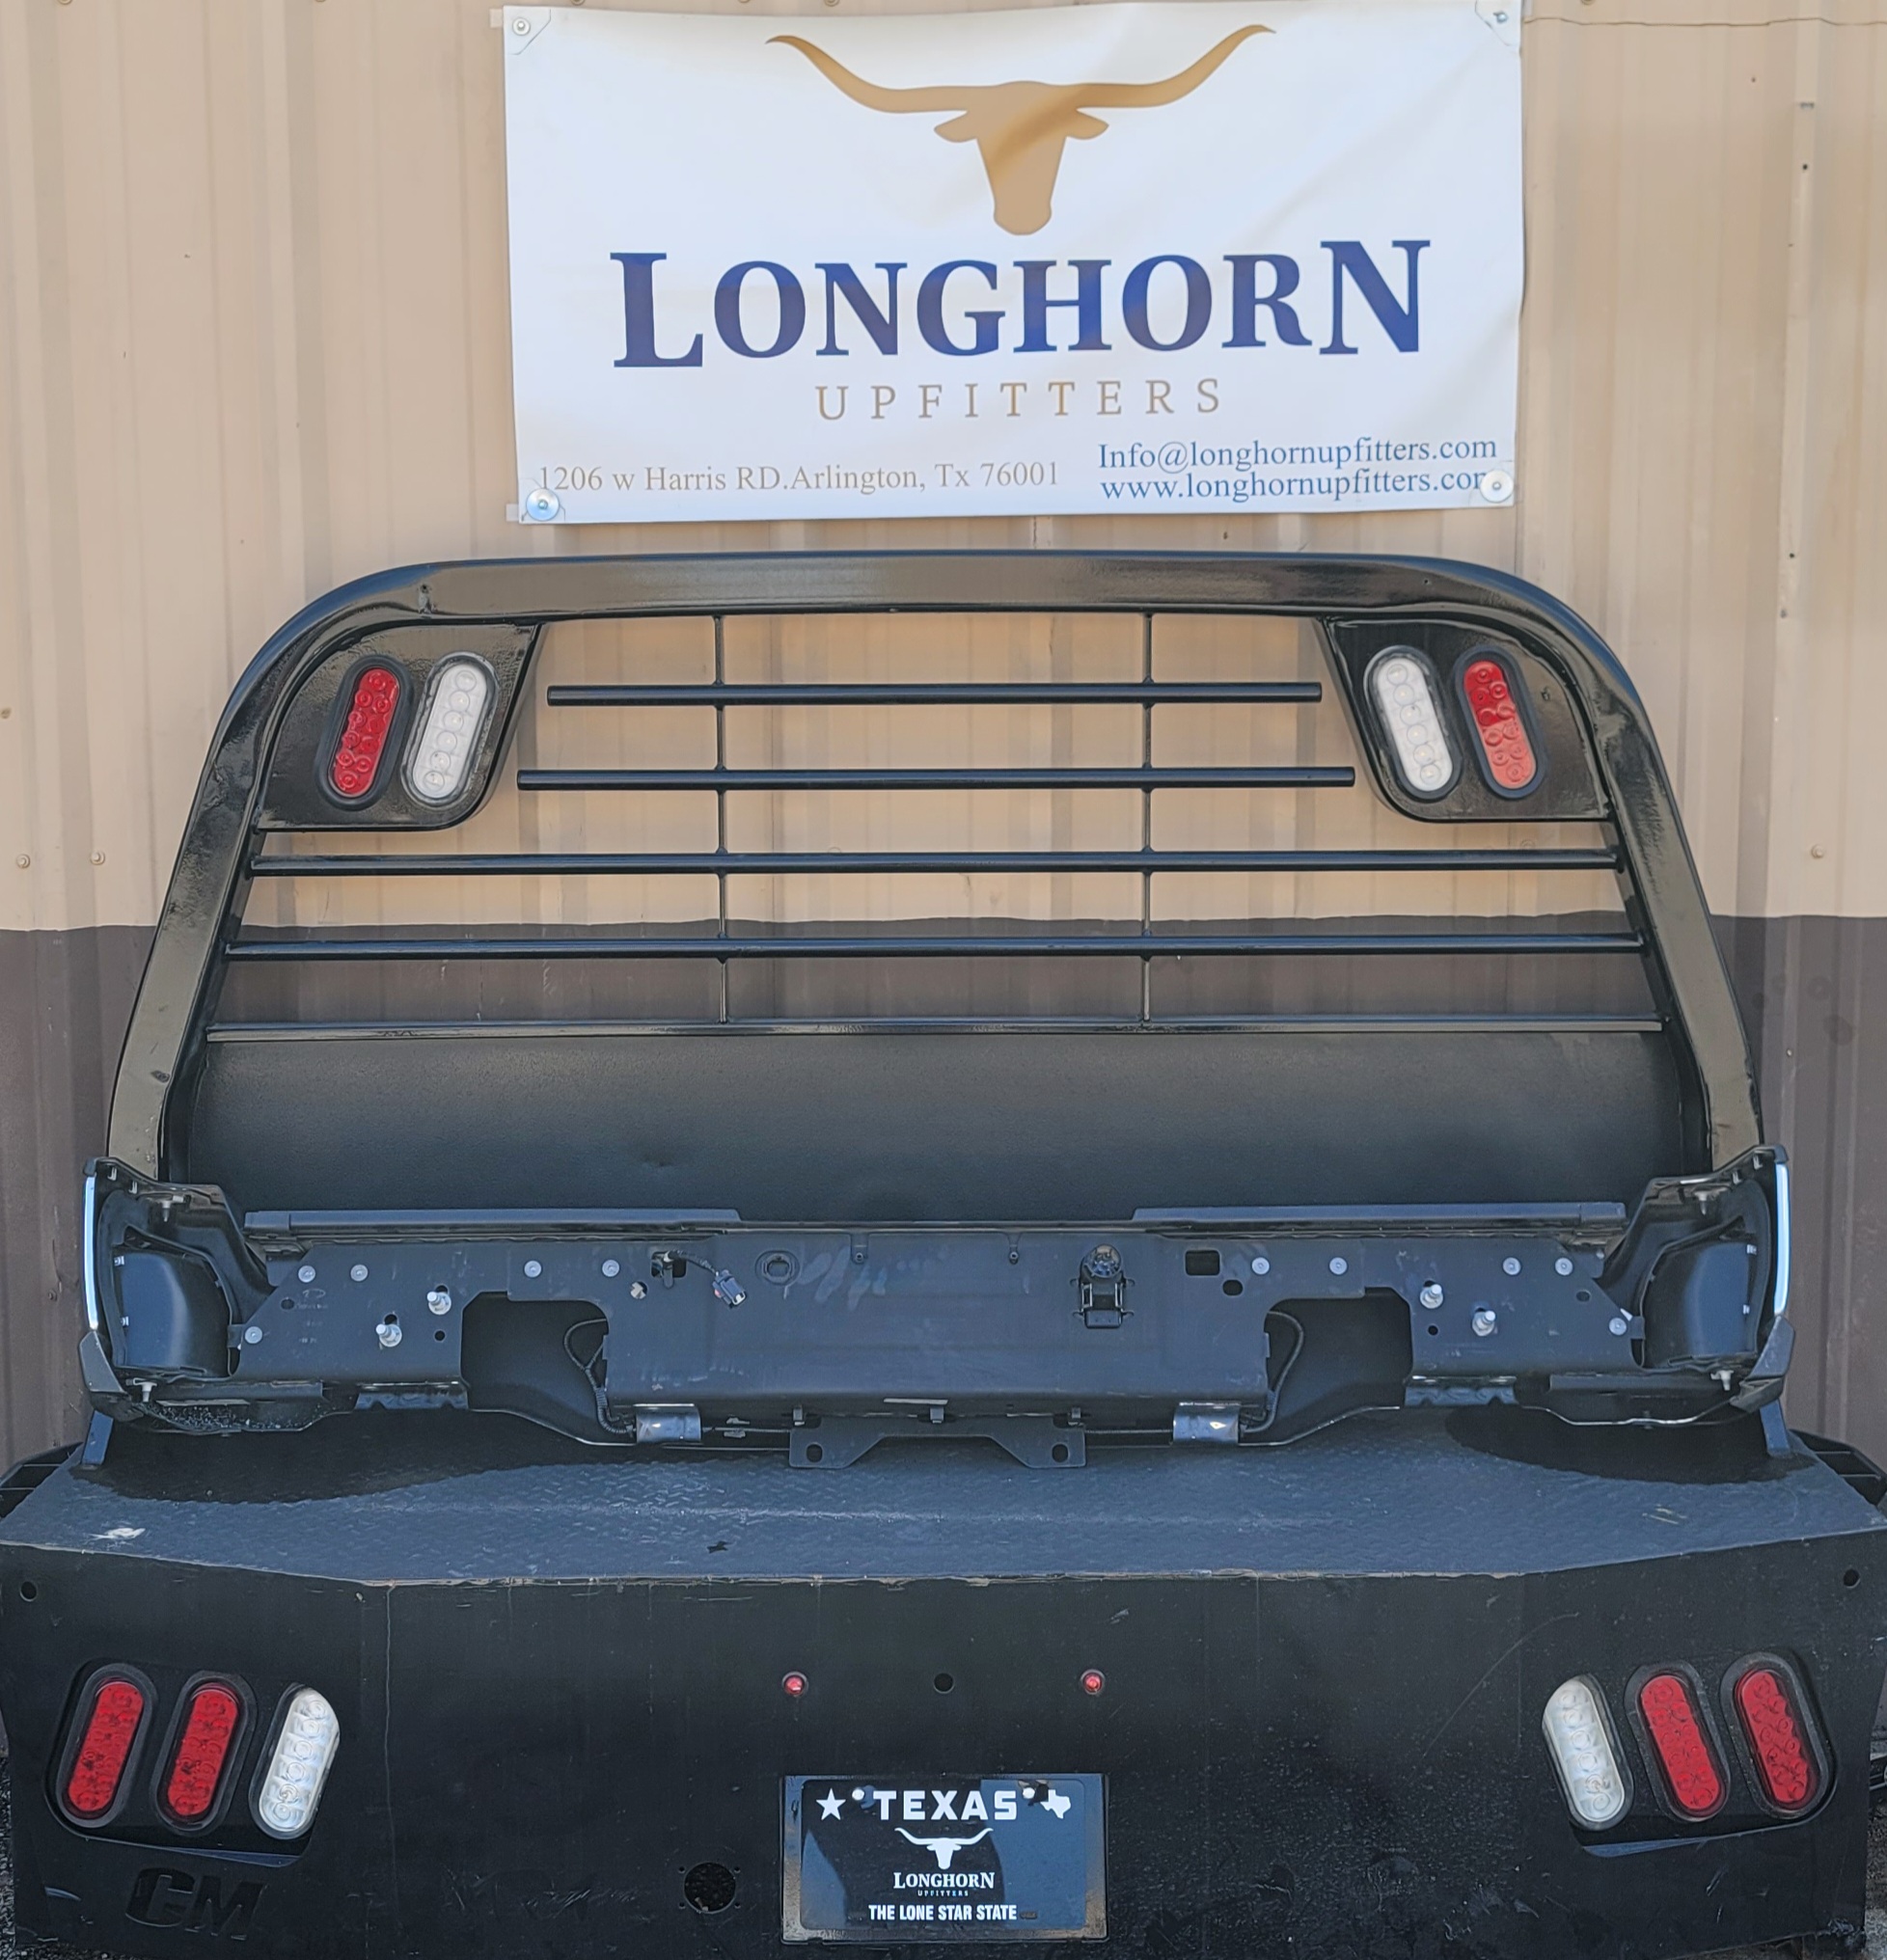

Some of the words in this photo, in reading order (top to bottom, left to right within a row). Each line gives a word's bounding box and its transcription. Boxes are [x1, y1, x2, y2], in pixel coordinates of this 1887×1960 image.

[610, 239, 1431, 368] LONGHORN
[815, 377, 1220, 421] UPFITTERS
[1098, 436, 1497, 475] Info@longhornupfitters.com
[539, 465, 603, 491] 1206
[612, 471, 635, 491] w
[644, 465, 726, 491] Harris
[934, 463, 970, 487] Tx
[980, 461, 1058, 487] 76001
[873, 1790, 1017, 1820] TEXAS
[893, 1872, 995, 1889] LONGHORN
[868, 1905, 895, 1920] THE
[899, 1905, 934, 1920] LONE
[938, 1905, 972, 1920] STAR
[975, 1905, 1017, 1920] STATE
